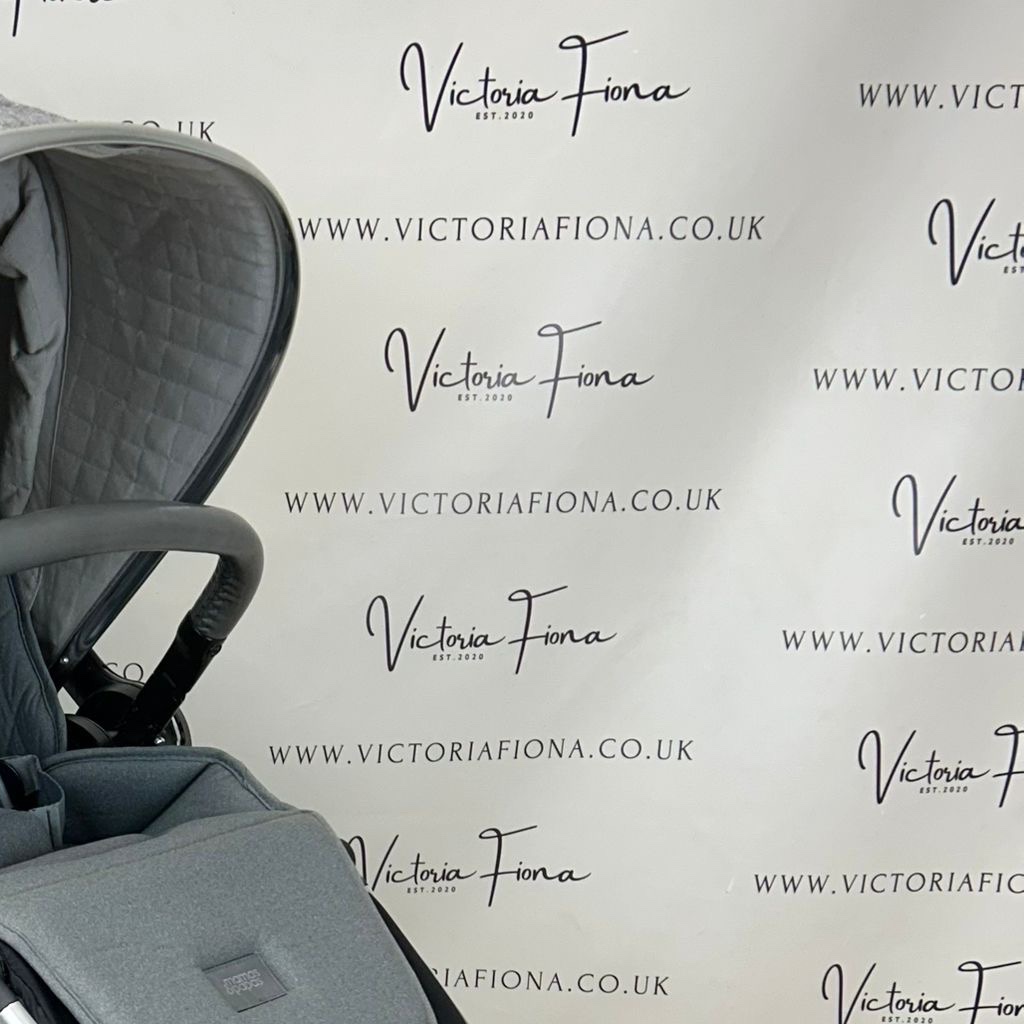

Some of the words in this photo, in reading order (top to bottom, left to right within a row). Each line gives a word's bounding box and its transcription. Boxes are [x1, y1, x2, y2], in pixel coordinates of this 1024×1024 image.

[400, 42, 558, 133] Victoria
[559, 30, 690, 137] Fiona
[475, 111, 535, 120] EST.2020
[297, 215, 766, 242] WWW.VICTORIAFIONA.CO.UK
[384, 327, 536, 412] Victoria
[537, 321, 655, 418] Fiona
[457, 393, 514, 402] EST.2020
[284, 488, 723, 516] WWW.VICTORIAFIONA.CO.UK
[961, 537, 1015, 546] EST.2020
[366, 595, 506, 673] Victoria
[507, 585, 618, 675] Fiona
[432, 653, 485, 661] EST.2020
[269, 737, 694, 765] WWW.VICTORIAFIONA.CO.UK
[857, 729, 991, 804] Victoria
[919, 786, 969, 794] EST.2020
[478, 824, 592, 907] Fiona
[406, 886, 457, 894] EST.2020
[432, 967, 670, 997] IAFIONA.CO.UK
[881, 1016, 934, 1024] EST.2020
